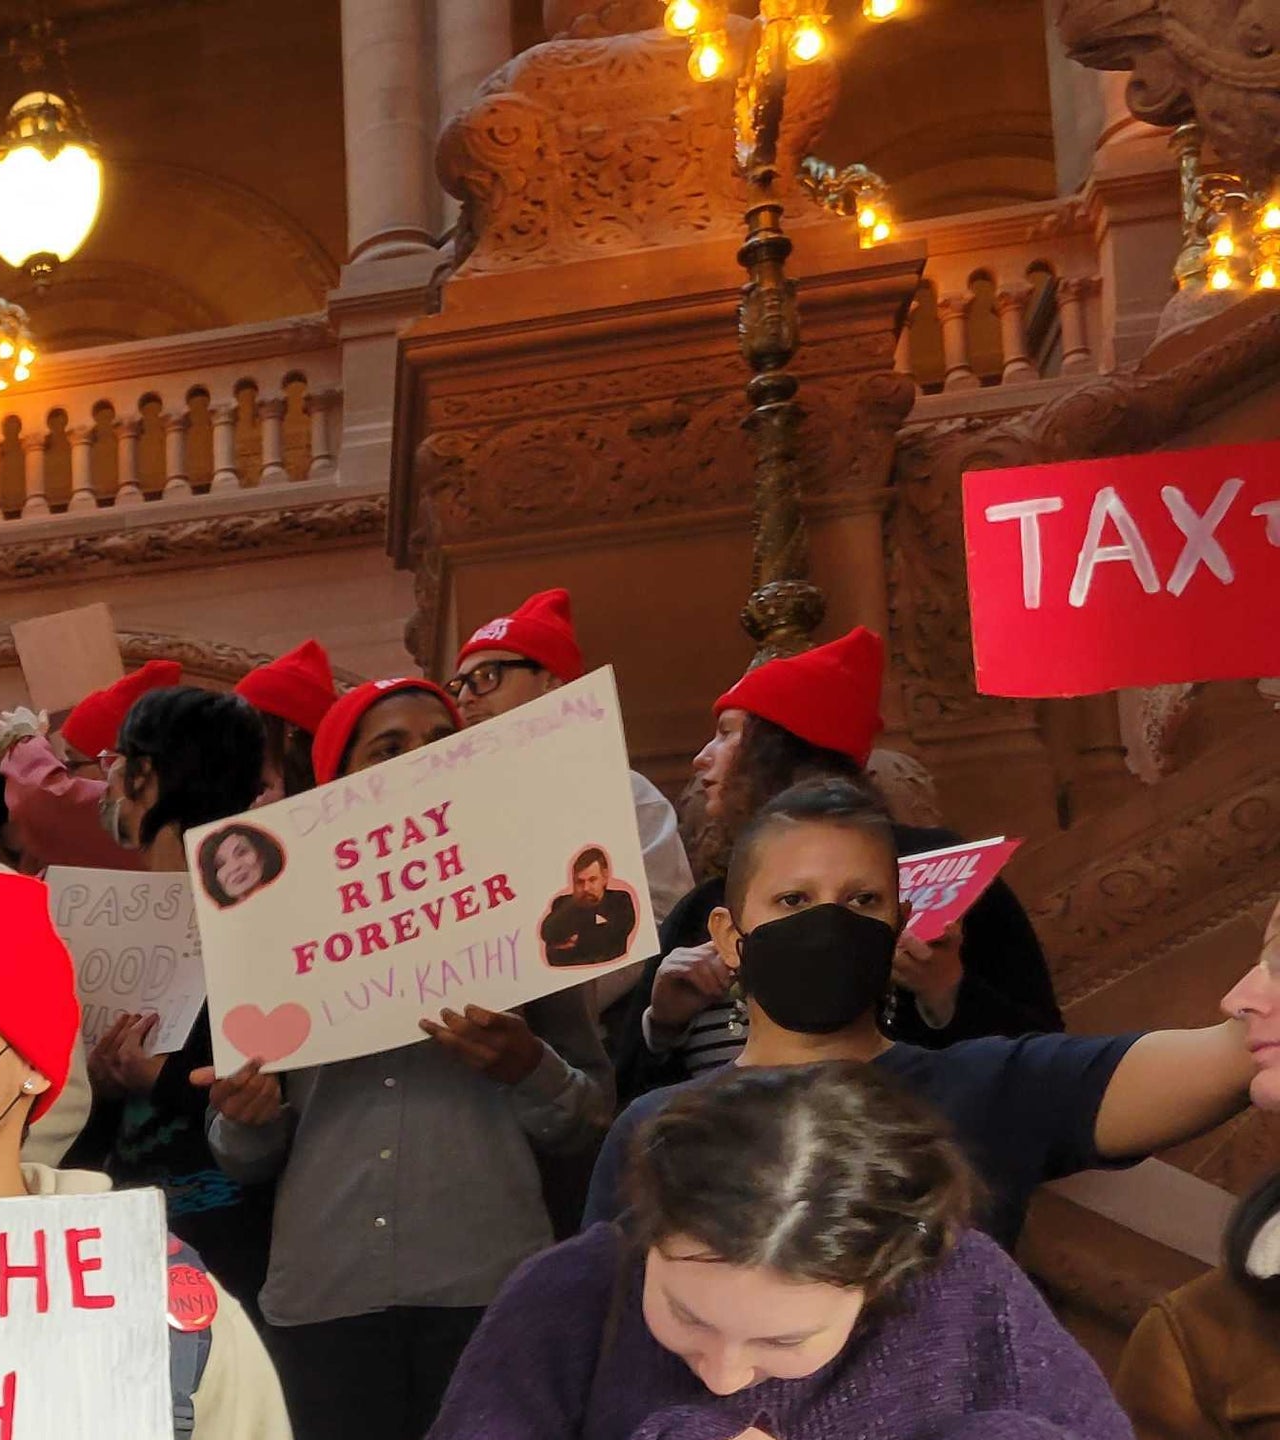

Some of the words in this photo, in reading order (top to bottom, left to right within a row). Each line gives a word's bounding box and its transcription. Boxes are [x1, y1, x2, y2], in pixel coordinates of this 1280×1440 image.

[985, 477, 1244, 610] TAX
[333, 800, 452, 870] STAY
[57, 884, 183, 927] PASS
[337, 844, 466, 915] RICH
[291, 873, 517, 976] FOREVER
[61, 937, 176, 1001] OOD
[415, 928, 521, 1005] KATHY
[167, 1270, 208, 1287] REE
